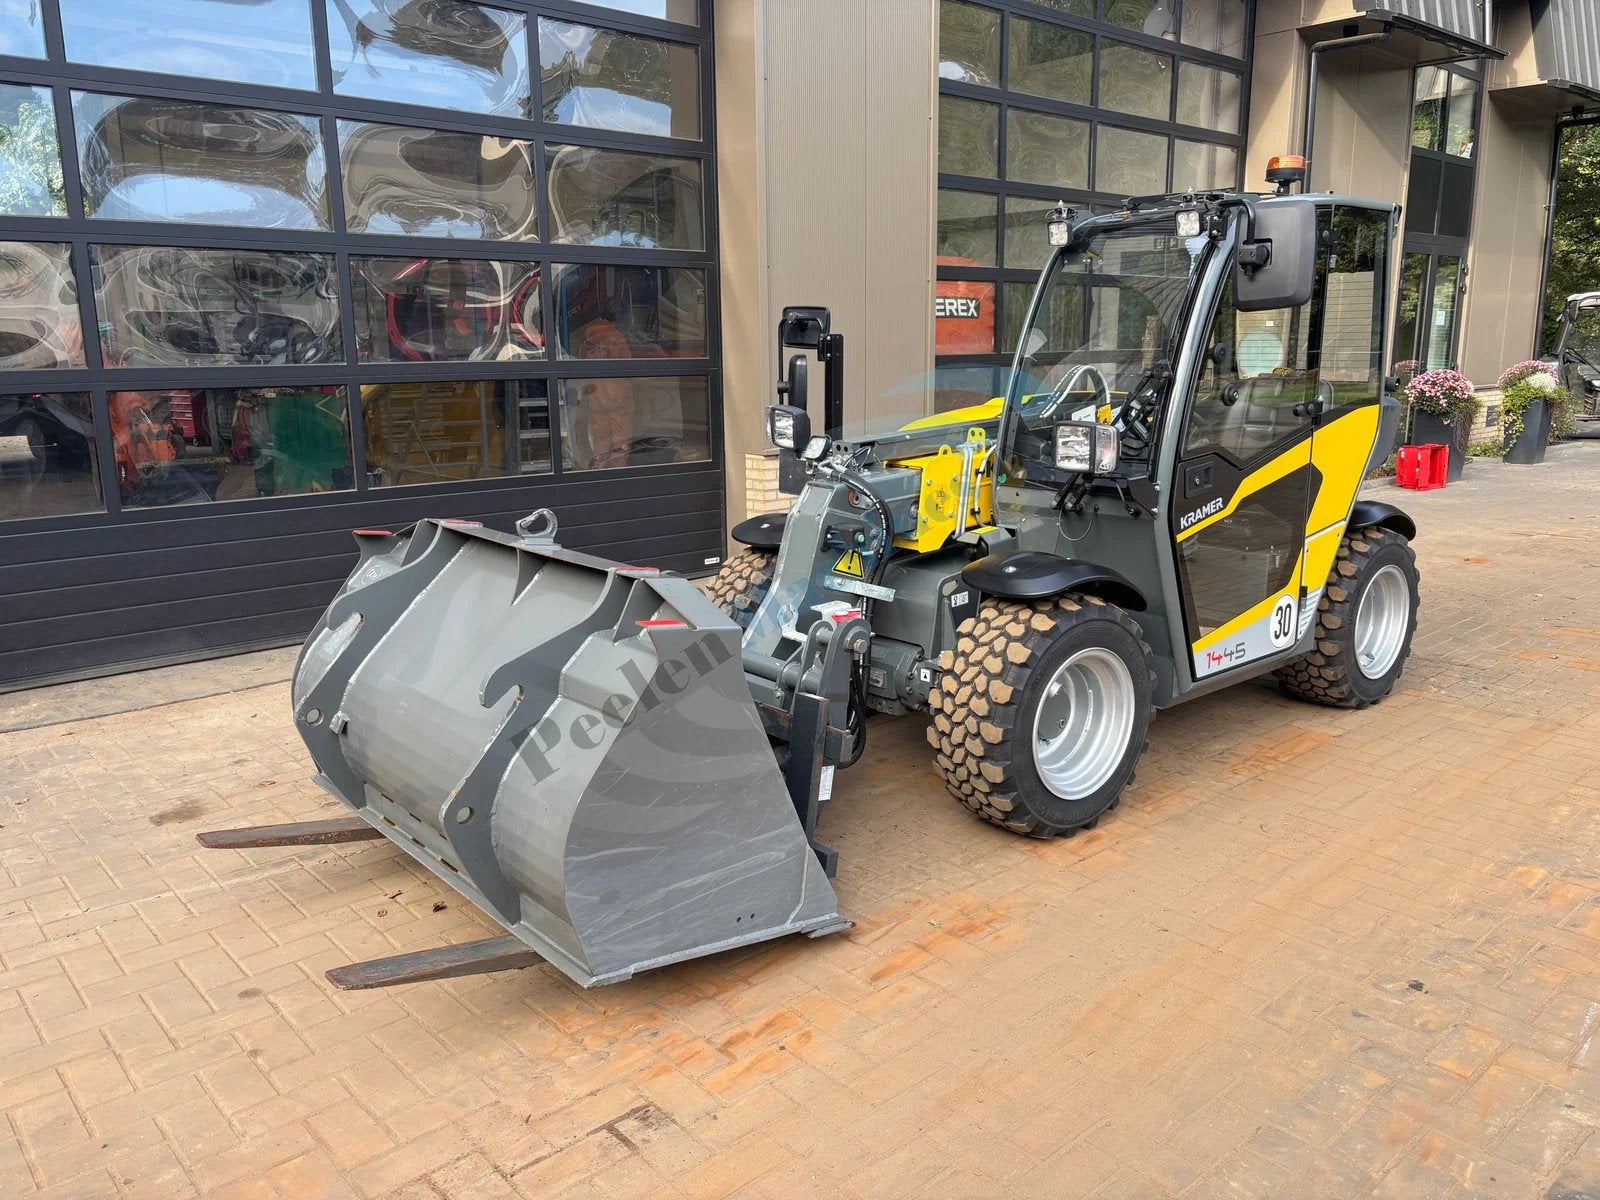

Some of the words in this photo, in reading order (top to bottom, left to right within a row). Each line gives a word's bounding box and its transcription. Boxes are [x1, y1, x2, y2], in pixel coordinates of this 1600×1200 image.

[1180, 497, 1224, 530] KRAMER
[1274, 603, 1292, 639] 30
[1206, 641, 1246, 669] 1445
